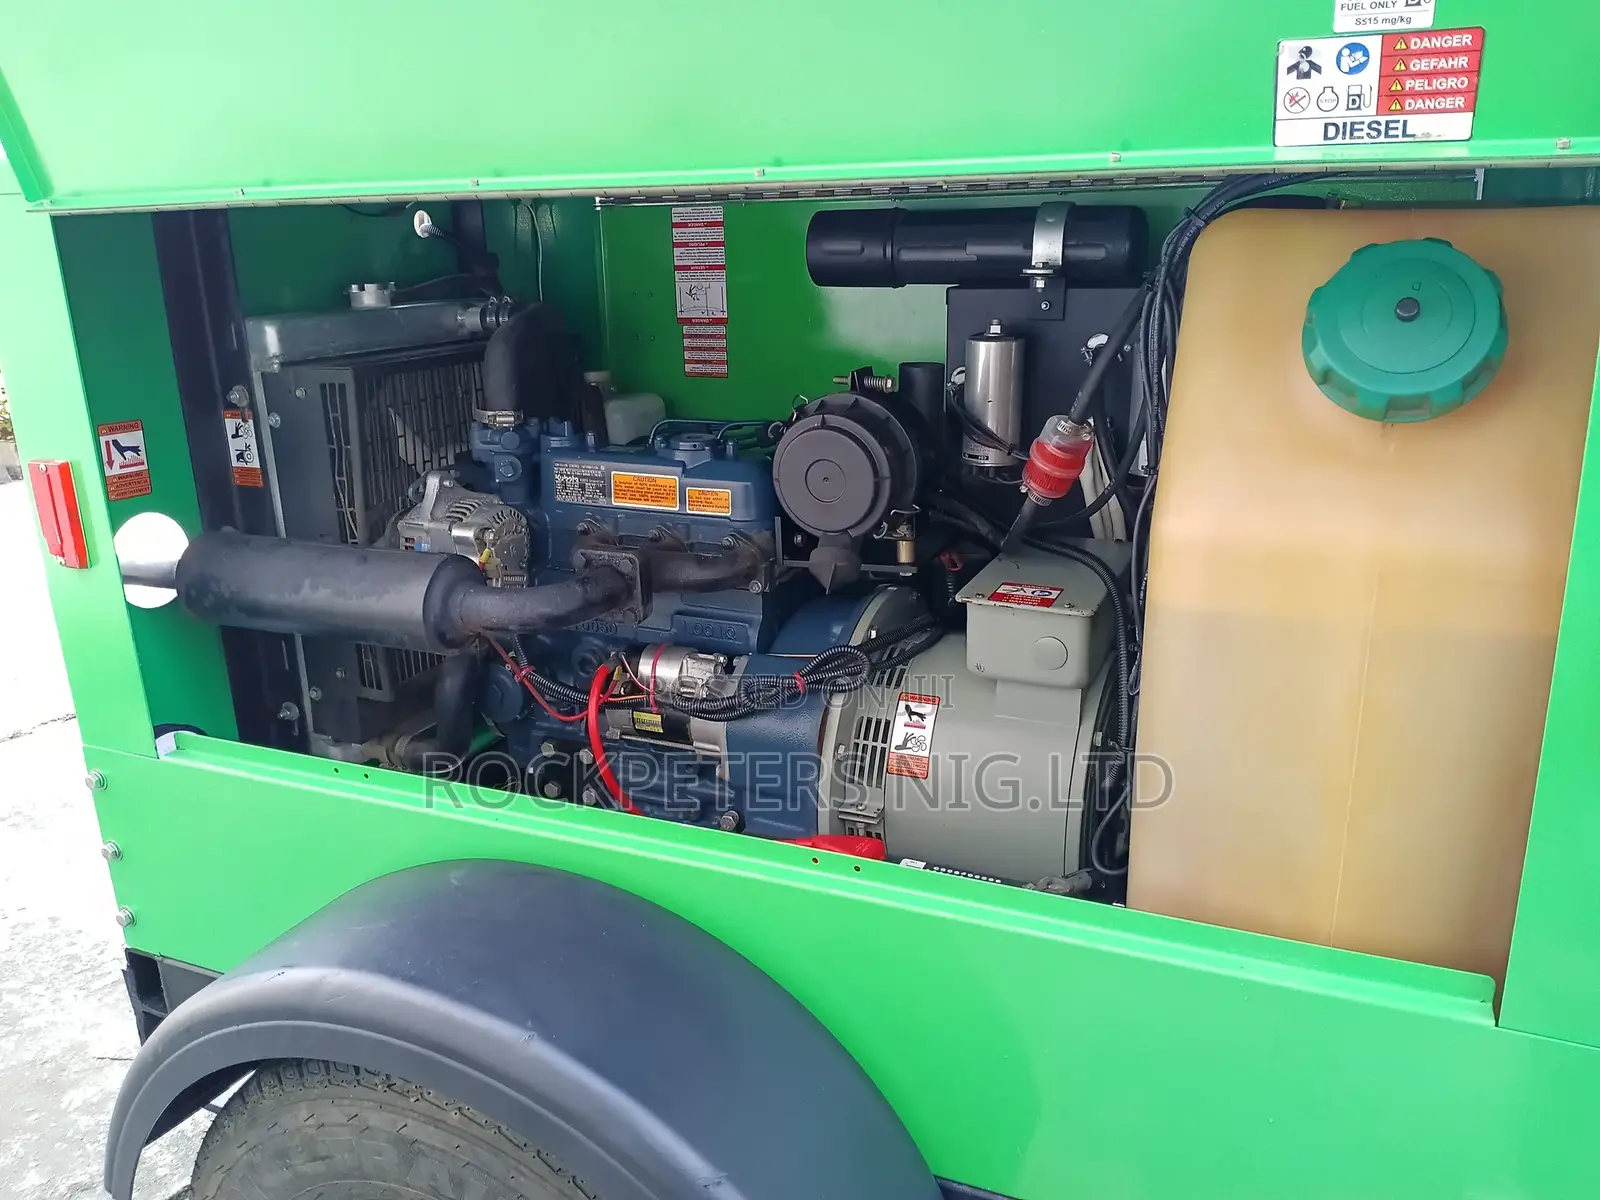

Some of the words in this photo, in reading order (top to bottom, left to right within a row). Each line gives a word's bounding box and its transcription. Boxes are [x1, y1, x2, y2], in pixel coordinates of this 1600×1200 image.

[1340, 2, 1366, 11] FUEL
[1370, 0, 1398, 10] ONLY
[1382, 15, 1412, 26] mg/kg
[1410, 34, 1472, 50] DANGER
[1409, 56, 1469, 71] GEFAHR
[1405, 76, 1469, 91] PELIGRO
[1404, 96, 1465, 111] DANGER
[1322, 119, 1417, 141] DIESEL
[107, 422, 140, 433] WARNING
[554, 474, 579, 482] Kubota
[632, 475, 657, 483] CAUTION
[909, 694, 936, 703] WARNING
